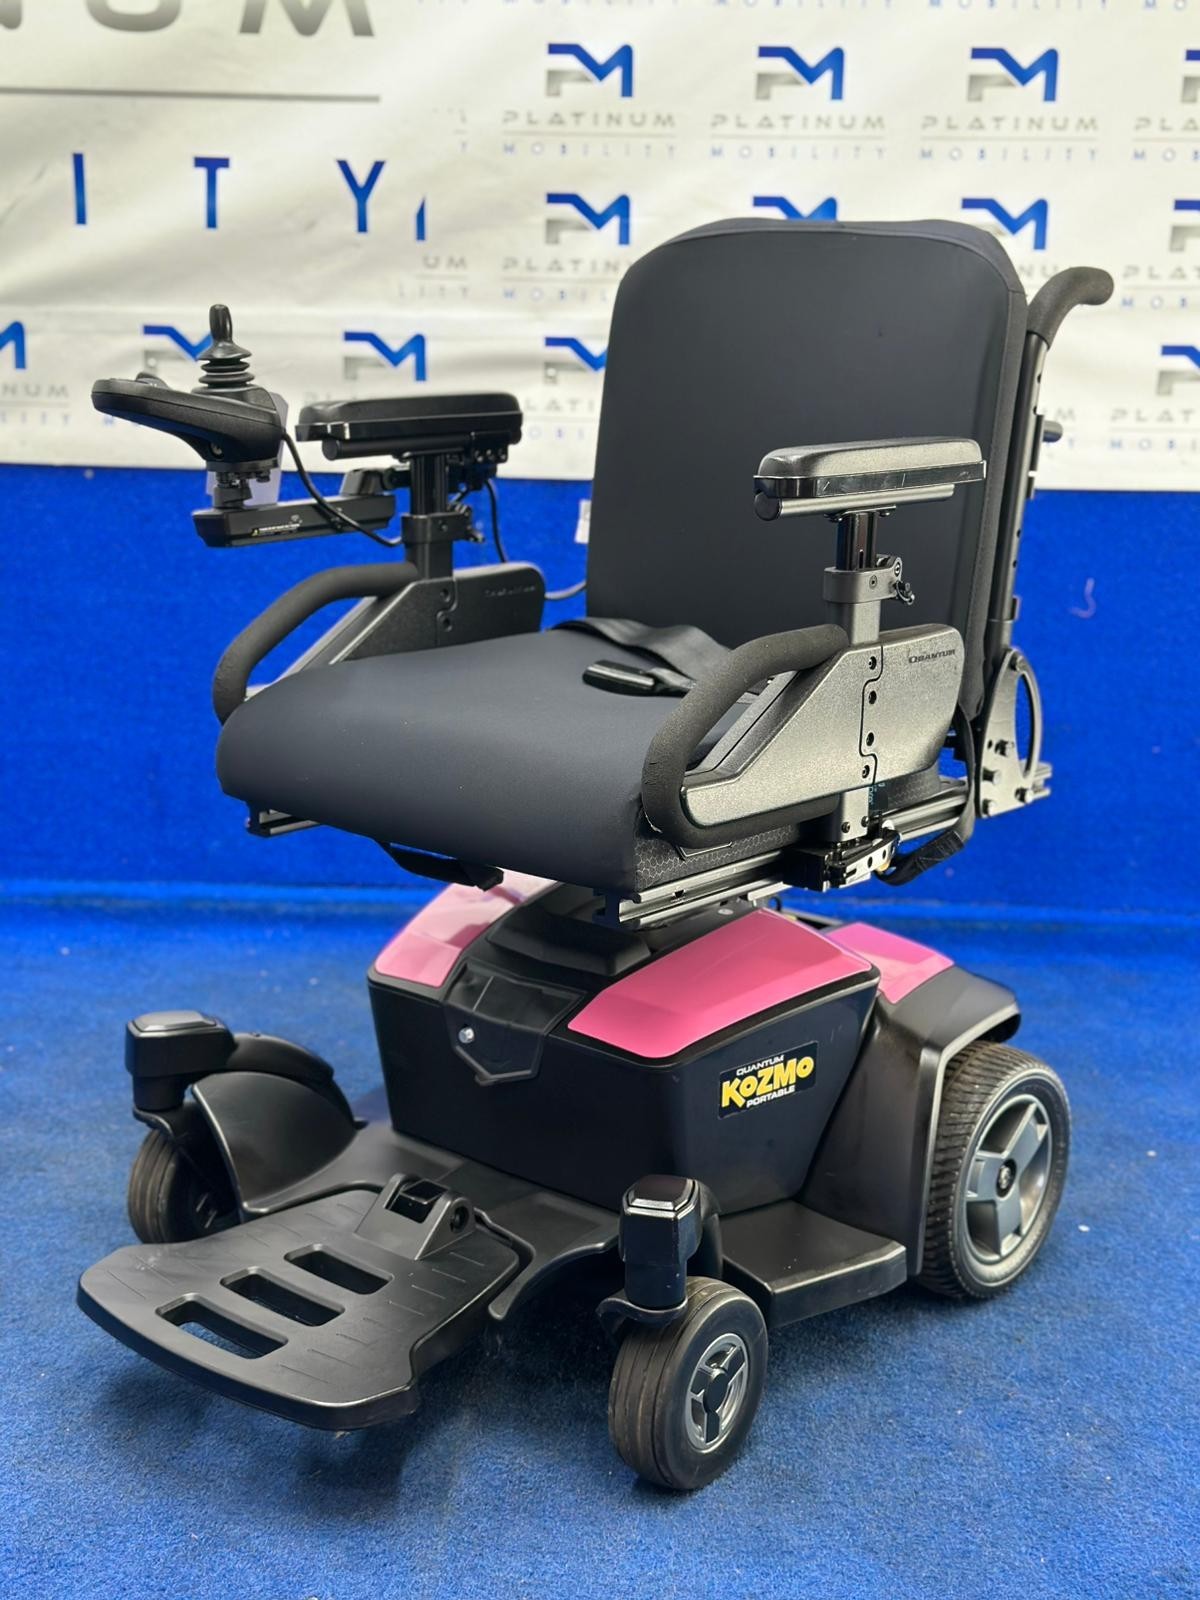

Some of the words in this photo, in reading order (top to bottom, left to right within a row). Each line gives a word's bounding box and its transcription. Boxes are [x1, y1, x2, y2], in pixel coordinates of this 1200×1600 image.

[503, 110, 676, 128] PLATINUM
[710, 113, 885, 130] PLATINUM
[921, 115, 1098, 132] PLATINUM
[503, 256, 633, 273] PLATIN
[736, 1054, 785, 1077] QUANTUM
[746, 1084, 796, 1108] PORTABLE
